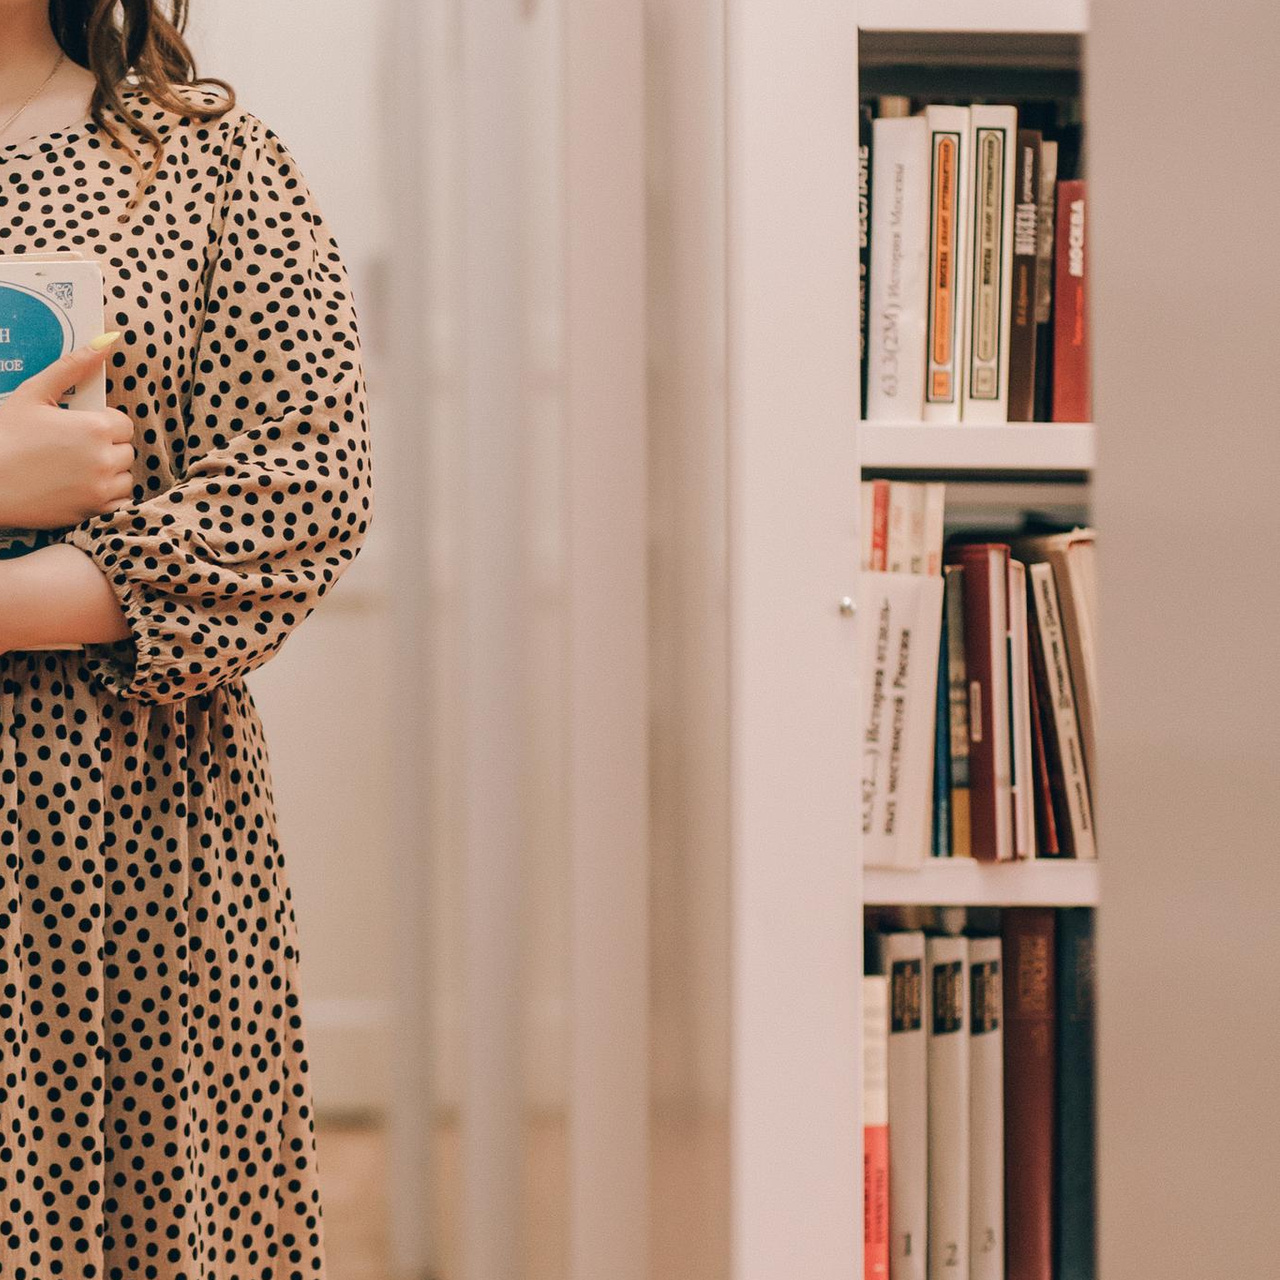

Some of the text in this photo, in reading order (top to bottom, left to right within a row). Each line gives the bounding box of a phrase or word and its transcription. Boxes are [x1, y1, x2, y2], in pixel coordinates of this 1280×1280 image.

[1070, 199, 1085, 277] МОСКВА
[889, 233, 903, 298] История
[901, 1232, 913, 1257] 1
[945, 1243, 959, 1267] 2
